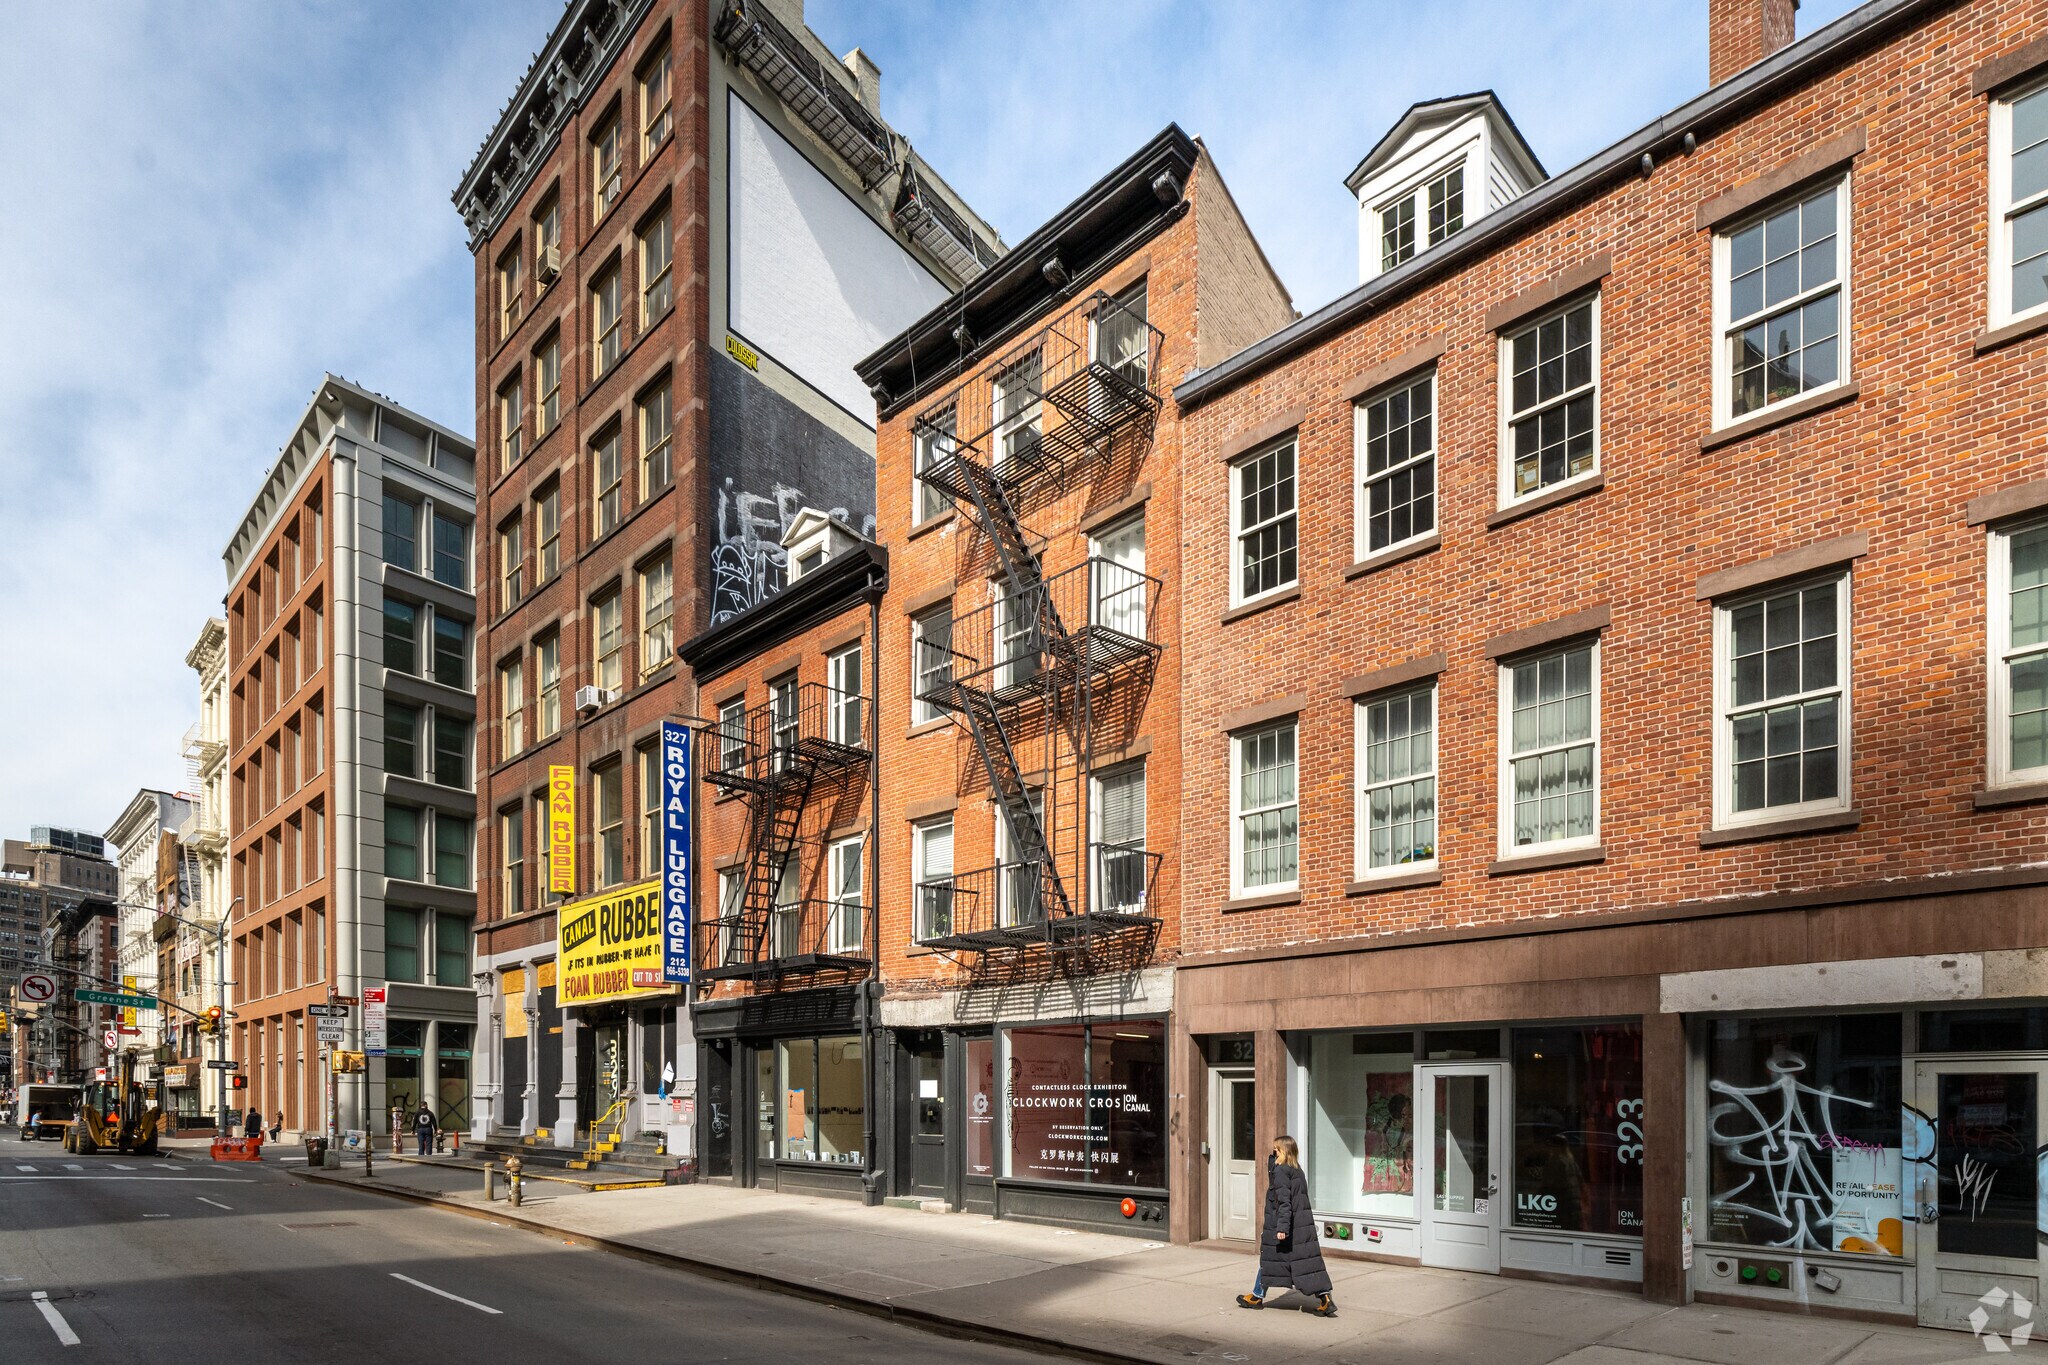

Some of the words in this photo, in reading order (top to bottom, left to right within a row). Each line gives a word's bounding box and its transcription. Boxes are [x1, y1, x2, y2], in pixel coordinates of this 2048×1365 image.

[664, 730, 687, 745] 327
[553, 768, 571, 814] FOAM
[667, 746, 686, 830] ROYAL
[553, 820, 572, 890] RUBBER
[668, 839, 686, 954] LUGGAGE
[563, 914, 595, 948] CANAL
[600, 891, 661, 946] RUBBE
[634, 944, 652, 958] HAVE
[670, 957, 686, 967] 212
[564, 973, 591, 999] FOAM
[593, 968, 630, 995] RUBBER
[633, 971, 644, 982] CUT
[645, 972, 653, 982] TO
[89, 993, 129, 1004] Greene
[132, 998, 144, 1006] St
[126, 977, 135, 1015] PK
[610, 1040, 618, 1098] 329
[1012, 1097, 1083, 1108] CLOCKWORK
[1089, 1098, 1121, 1108] CROS
[1125, 1094, 1137, 1103] ON
[1125, 1103, 1151, 1112] CANAL
[1617, 1098, 1644, 1165] 323
[1040, 1149, 1085, 1161] 克罗斯钟表
[1090, 1151, 1119, 1163] 快闪展
[1867, 1183, 1896, 1192] EASE
[1517, 1193, 1558, 1212] LKG
[1620, 1219, 1644, 1227] CANA
